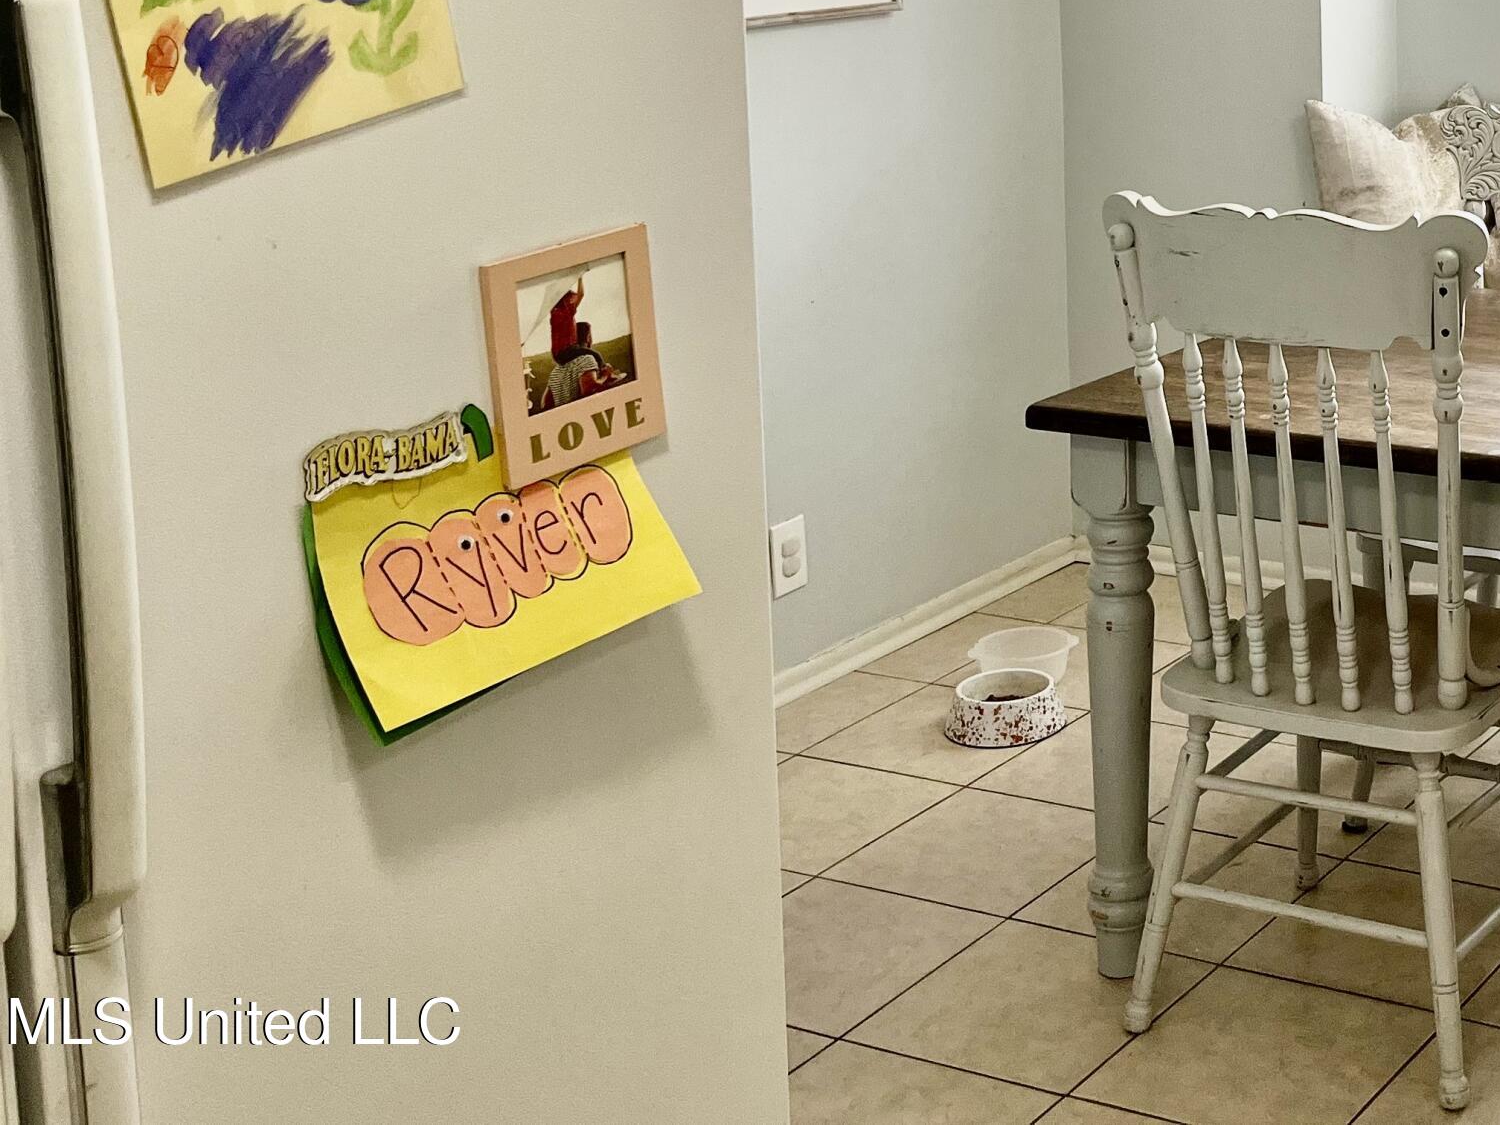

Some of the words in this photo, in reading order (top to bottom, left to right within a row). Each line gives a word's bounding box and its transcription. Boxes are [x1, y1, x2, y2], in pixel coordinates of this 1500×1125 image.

[312, 420, 460, 494] FLORA-BAMA
[529, 397, 646, 465] LOVE
[378, 488, 604, 633] Ryver
